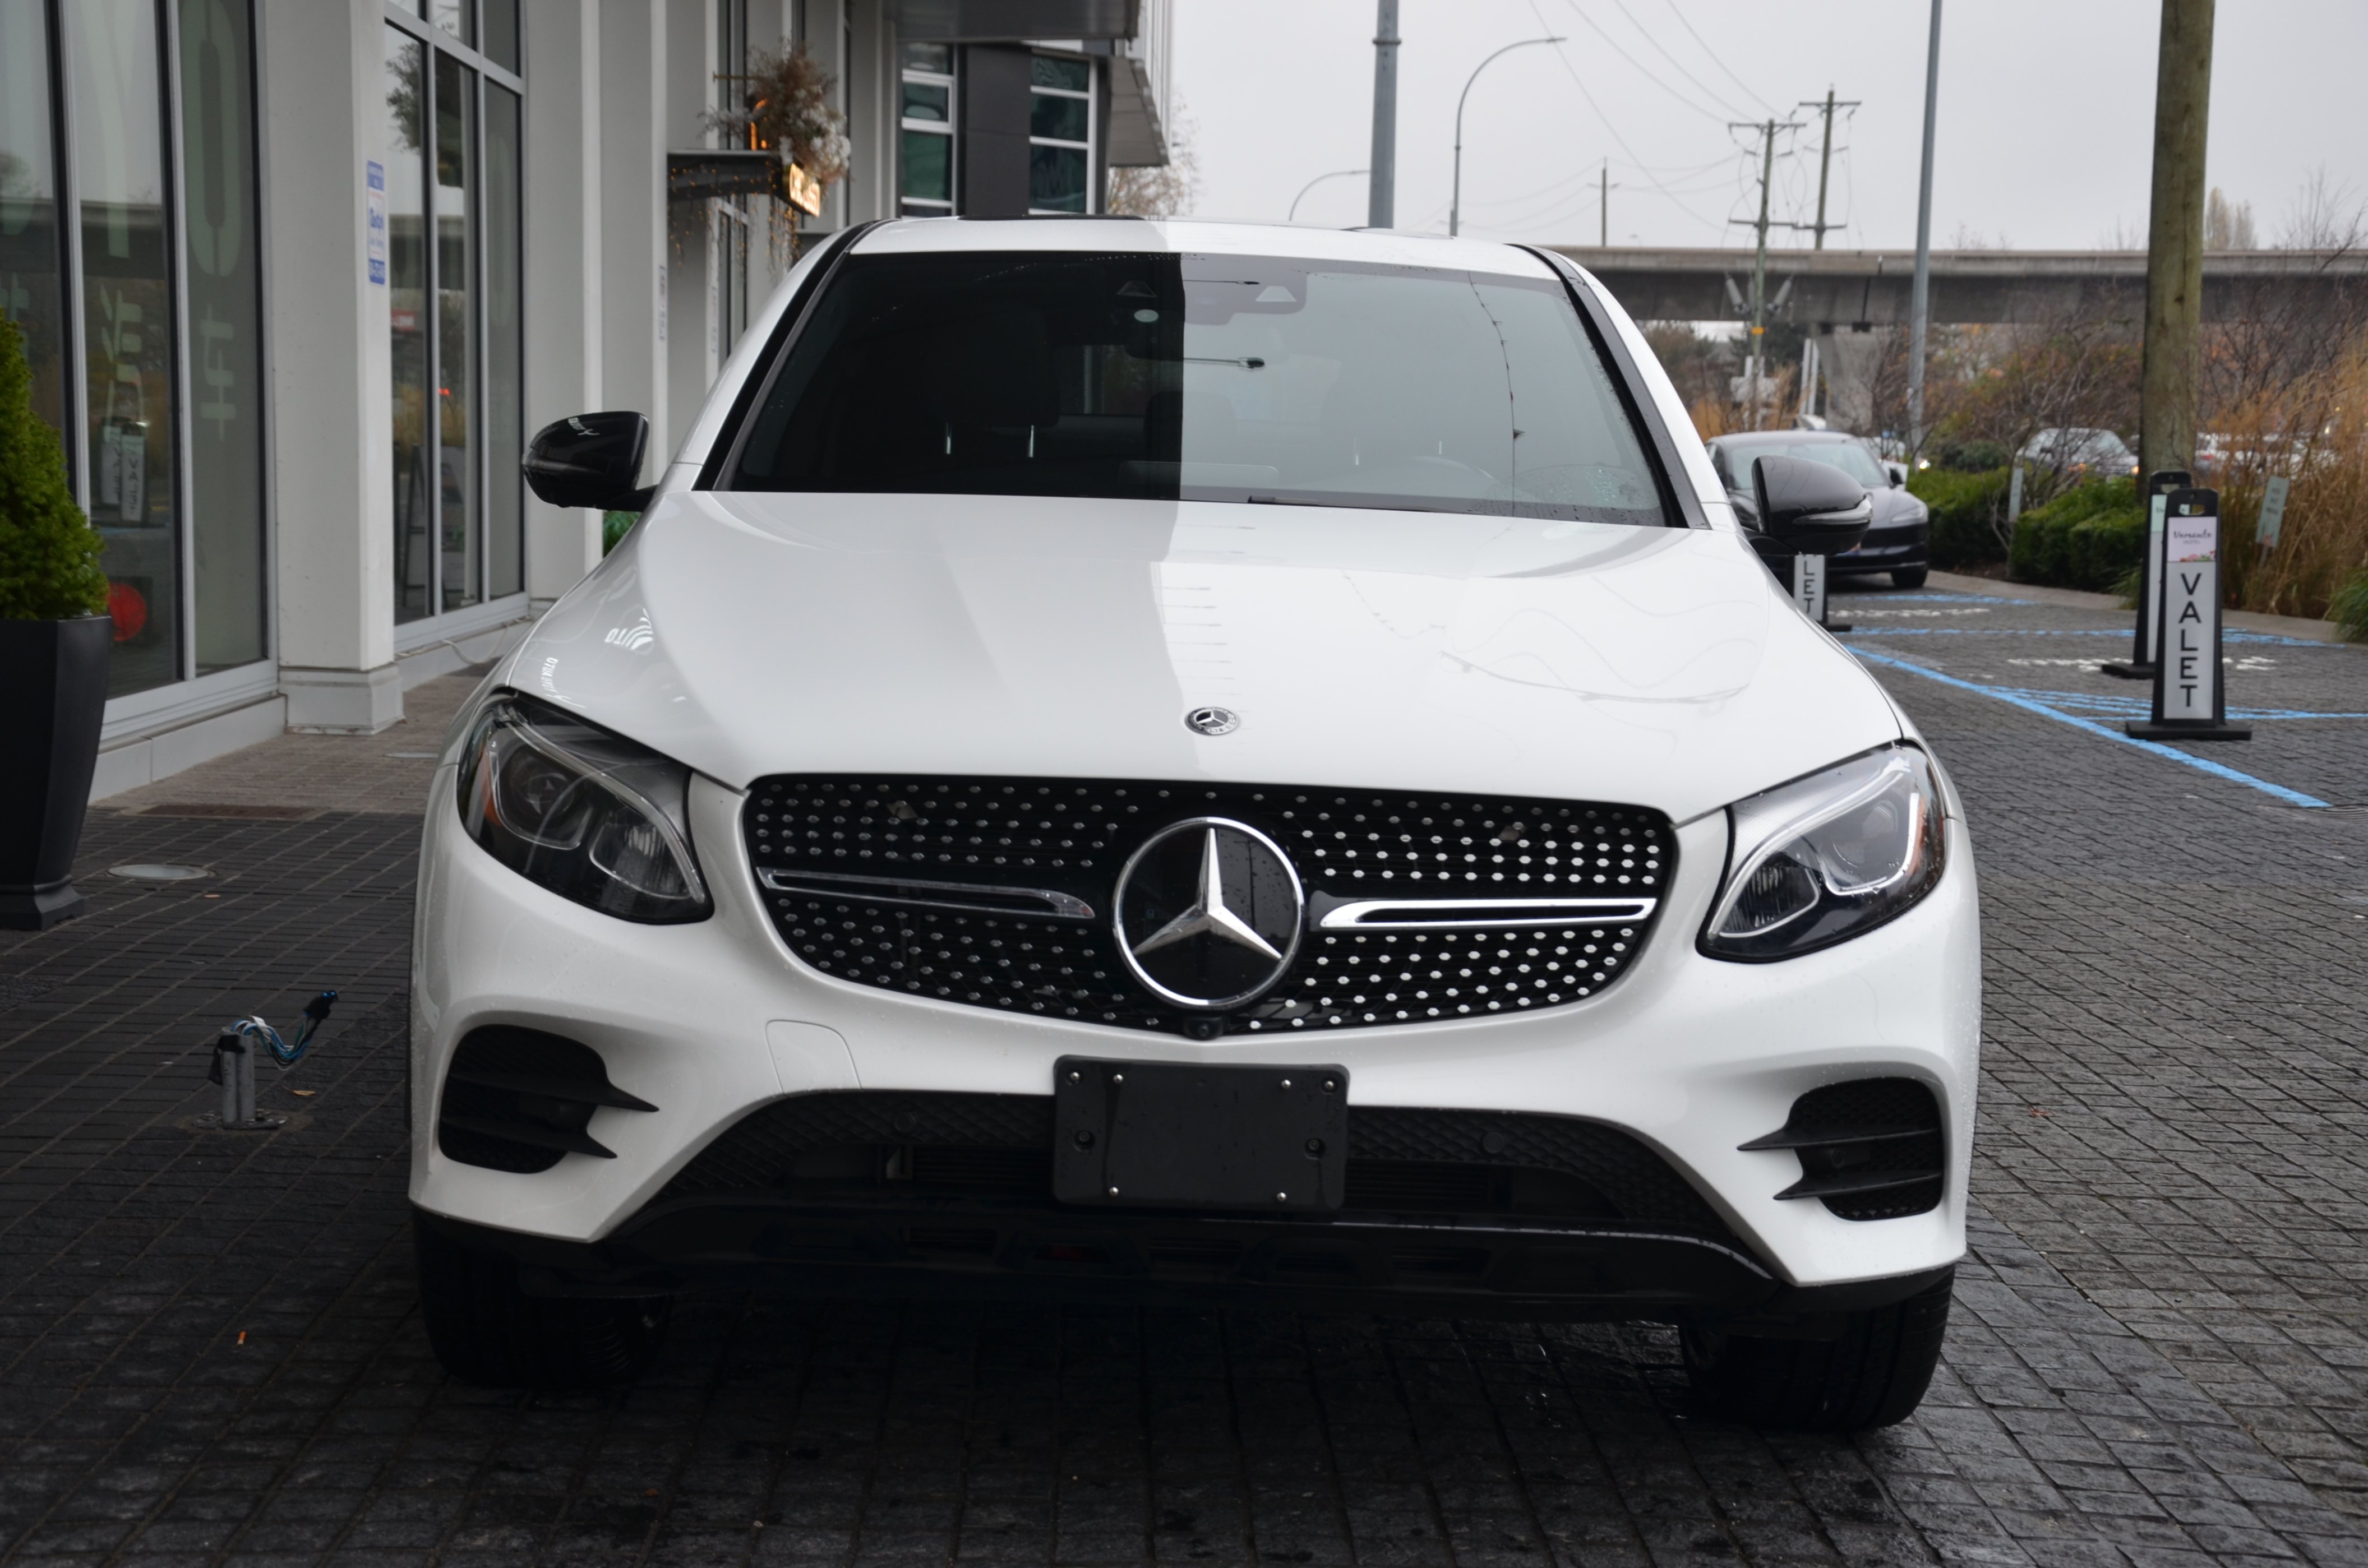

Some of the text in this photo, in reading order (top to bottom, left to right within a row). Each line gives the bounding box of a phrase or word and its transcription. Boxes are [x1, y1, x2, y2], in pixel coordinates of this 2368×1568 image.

[2173, 529, 2212, 539] Versante
[1803, 556, 1815, 614] LET
[2178, 573, 2201, 707] VALET
